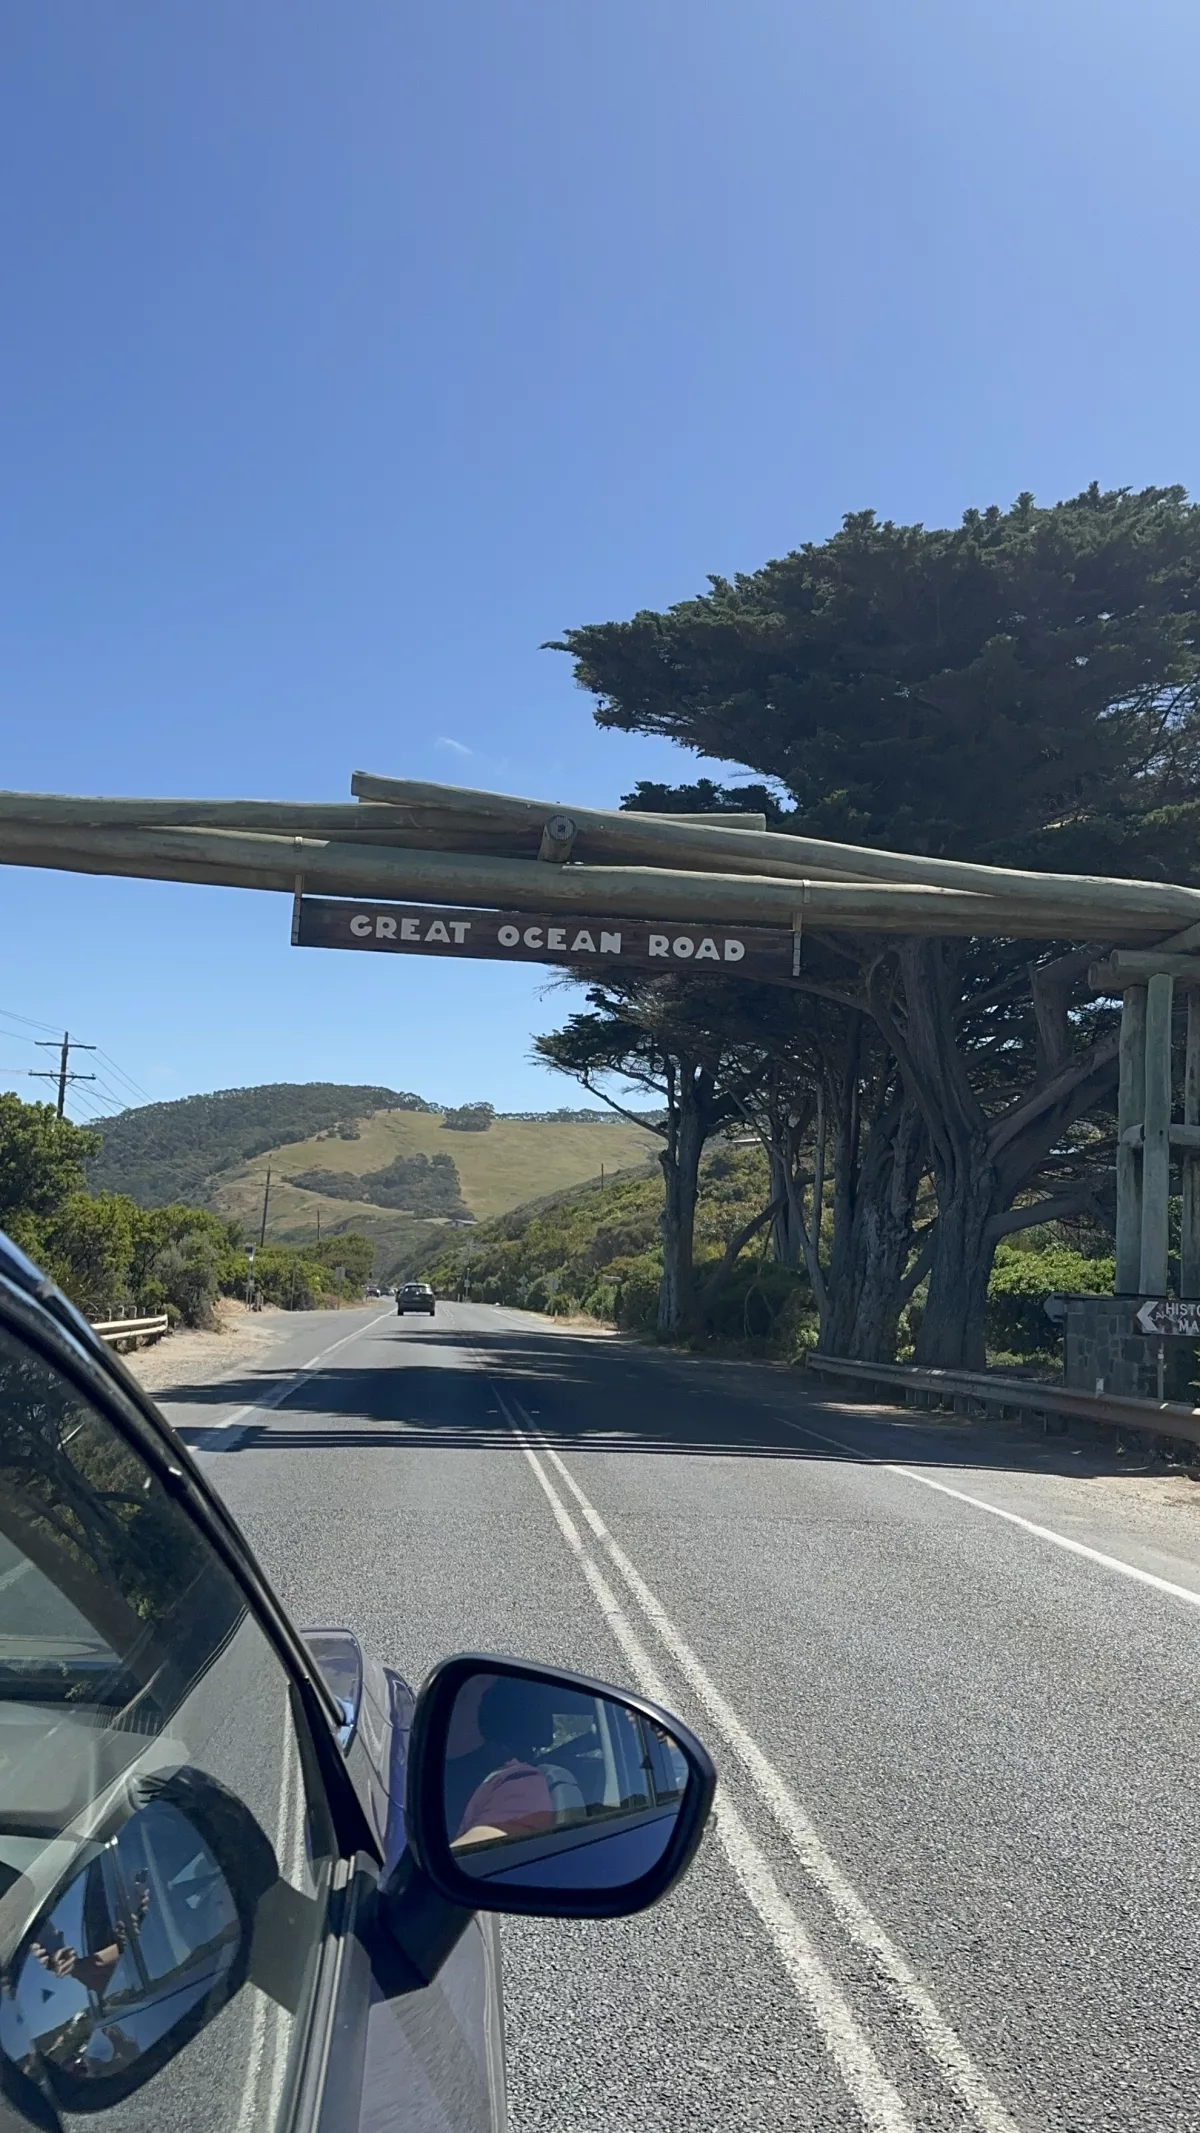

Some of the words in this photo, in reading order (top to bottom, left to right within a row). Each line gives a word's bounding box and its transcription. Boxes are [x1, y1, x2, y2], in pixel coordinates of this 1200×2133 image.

[350, 915, 471, 943] GREAT
[497, 925, 621, 954] OCEAN
[648, 934, 746, 962] ROAD
